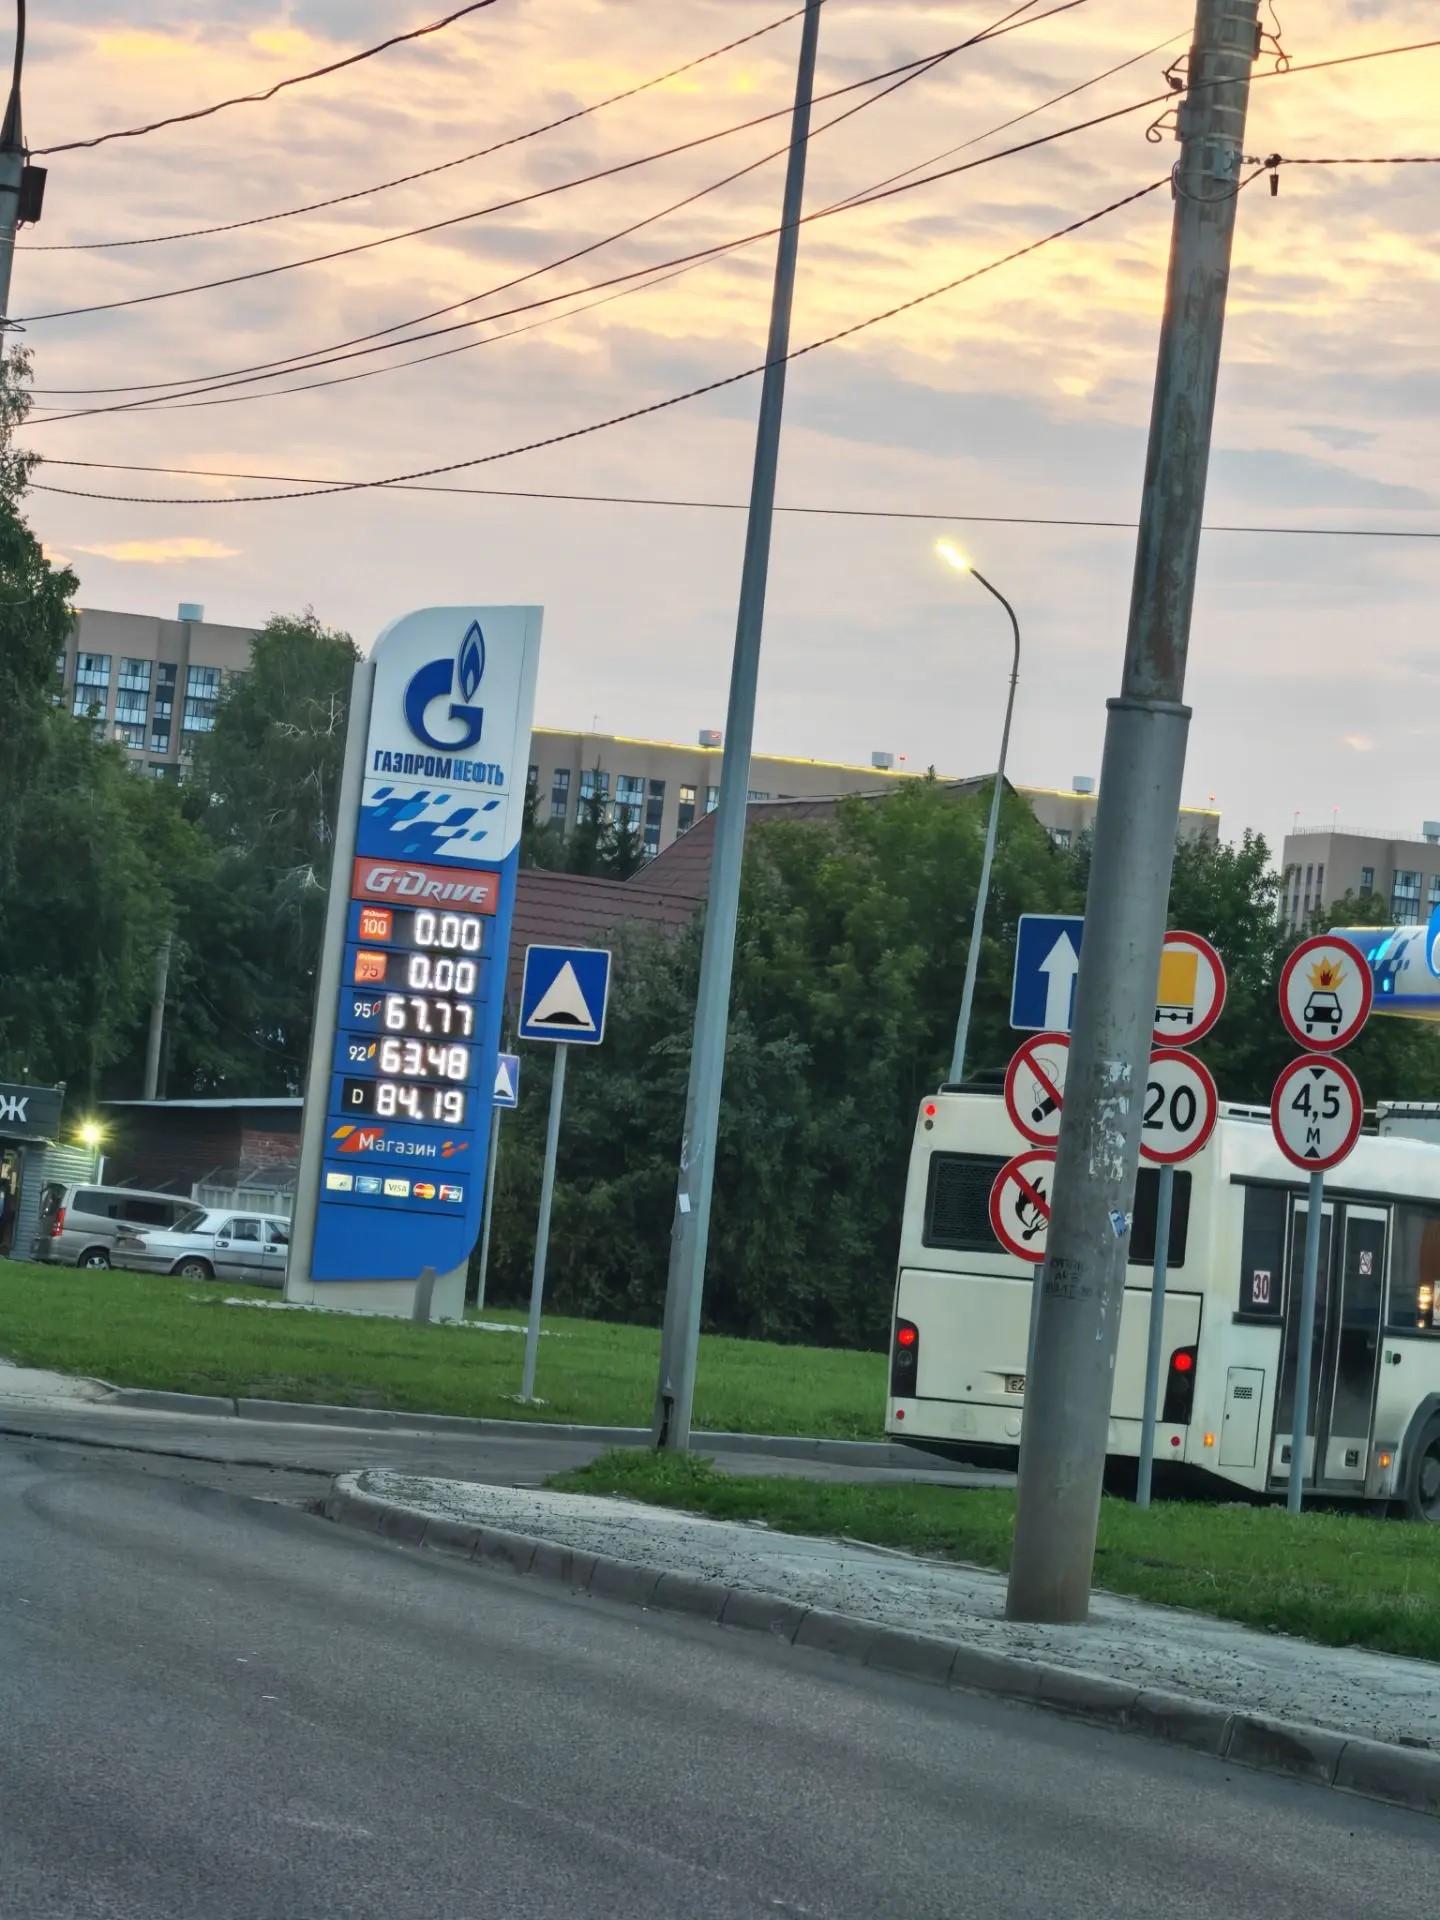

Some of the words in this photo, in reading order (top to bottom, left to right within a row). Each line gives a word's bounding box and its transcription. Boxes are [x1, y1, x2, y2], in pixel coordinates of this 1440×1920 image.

[373, 750, 505, 786] ГАЗПРОМНЕФТЬ
[363, 918, 387, 935] 100
[414, 912, 481, 950] 0.00
[408, 956, 476, 994] 0.00
[353, 1002, 372, 1018] 95
[385, 996, 473, 1036] 67.77
[349, 1046, 367, 1062] 92
[380, 1040, 468, 1080] 63.48
[351, 1088, 364, 1104] D
[376, 1083, 464, 1123] 84.19
[1142, 1082, 1197, 1132] 20
[1291, 1083, 1340, 1123] 4,5
[358, 1132, 436, 1157] Магазин
[387, 1183, 408, 1193] VISA
[1253, 1273, 1269, 1300] 30
